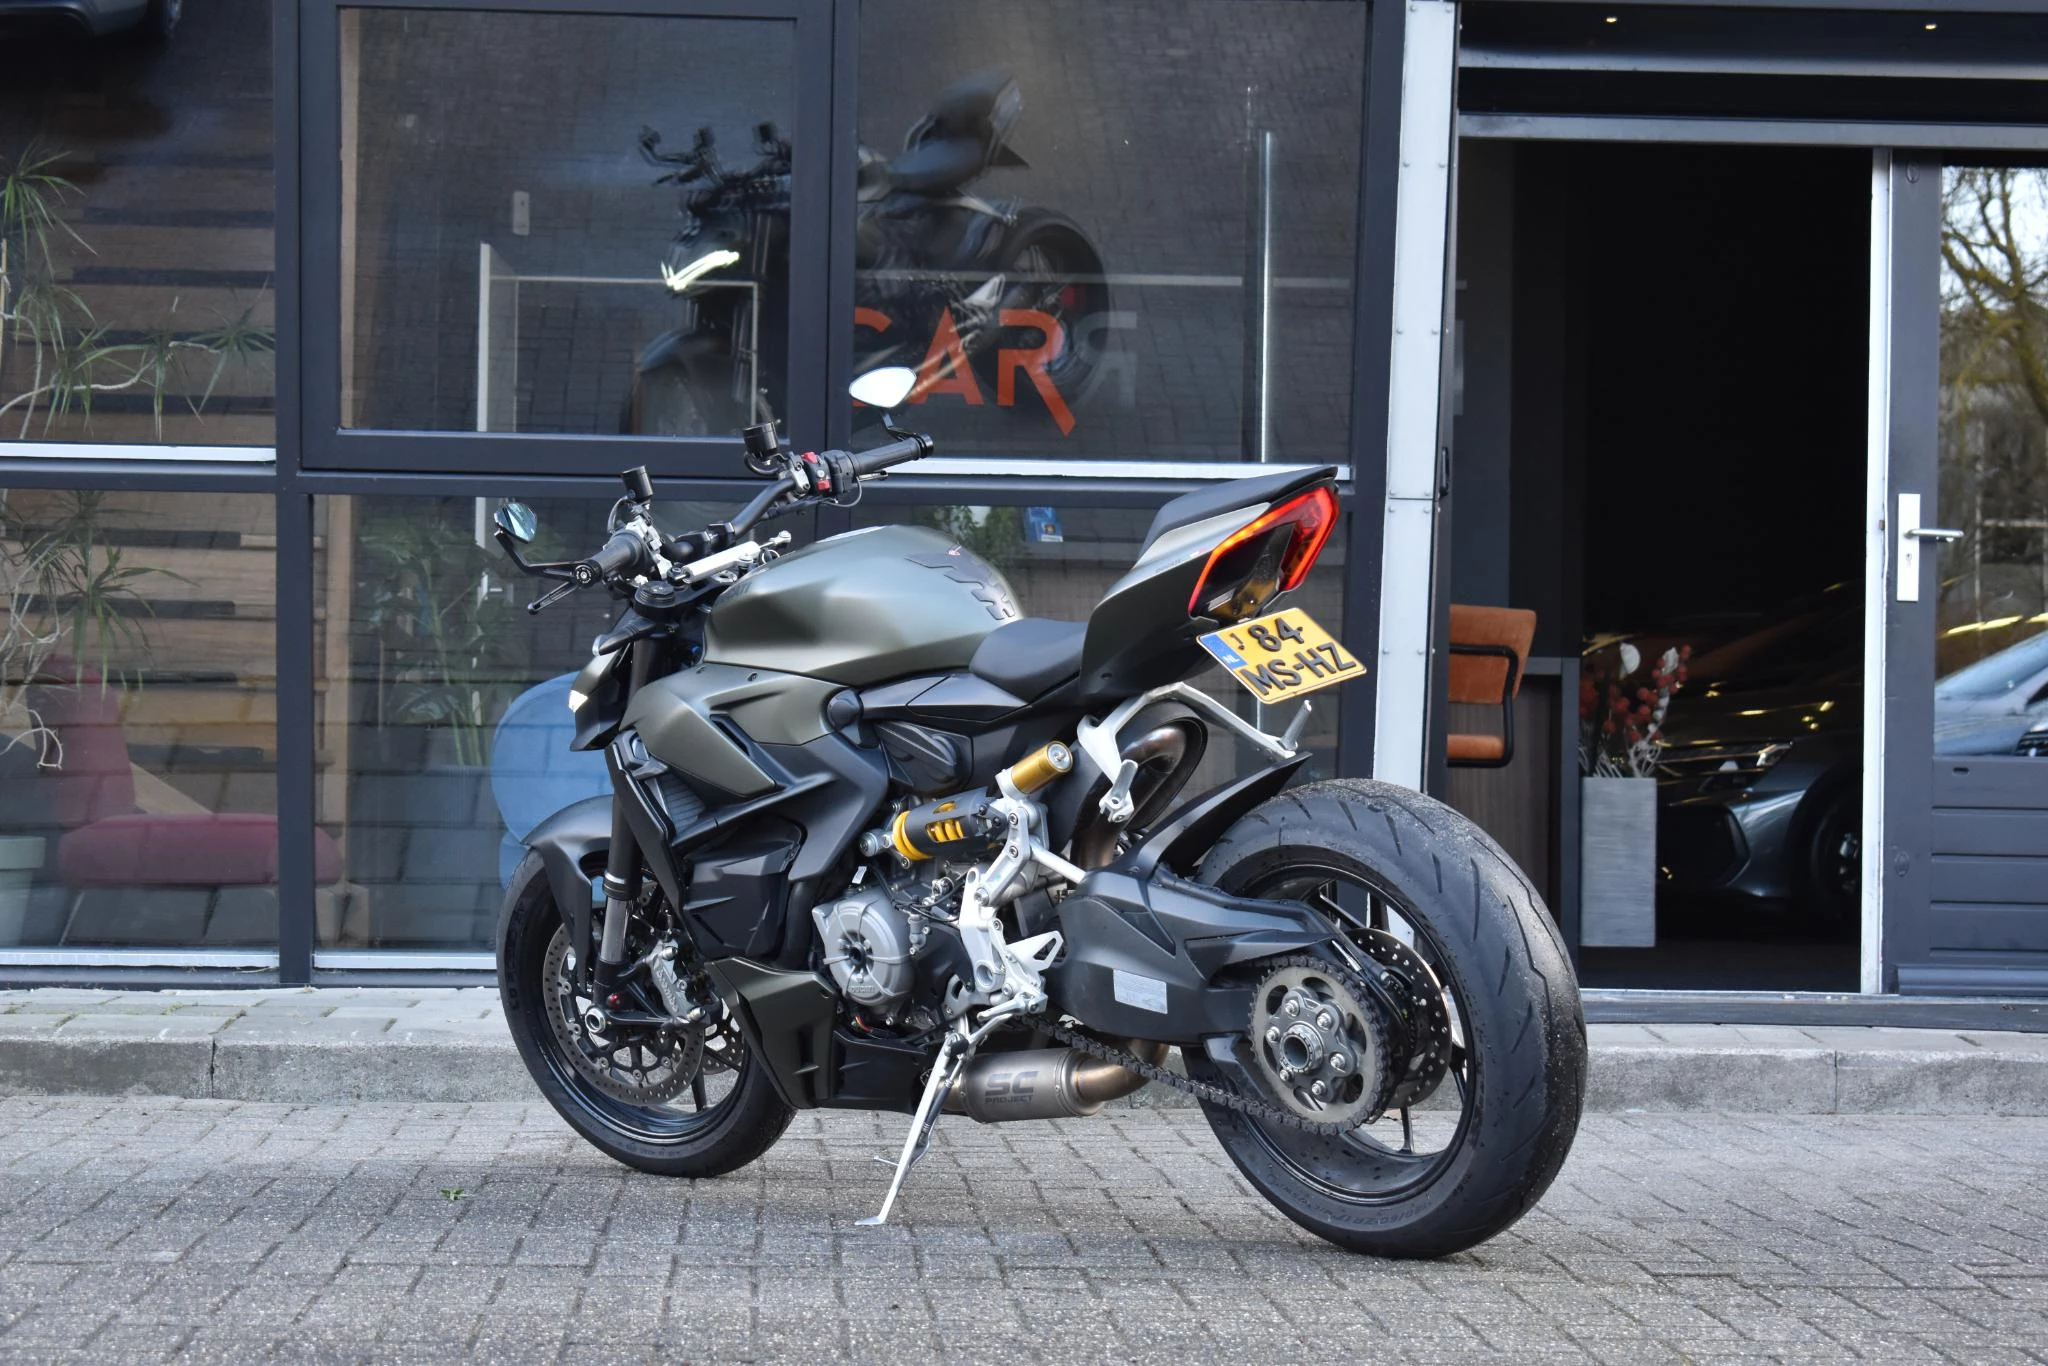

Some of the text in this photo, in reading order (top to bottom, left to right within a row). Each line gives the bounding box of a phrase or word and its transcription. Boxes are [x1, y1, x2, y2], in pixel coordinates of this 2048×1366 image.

[1248, 617, 1304, 652] 84
[1240, 642, 1357, 695] MS-HZ
[984, 1070, 1039, 1097] SC
